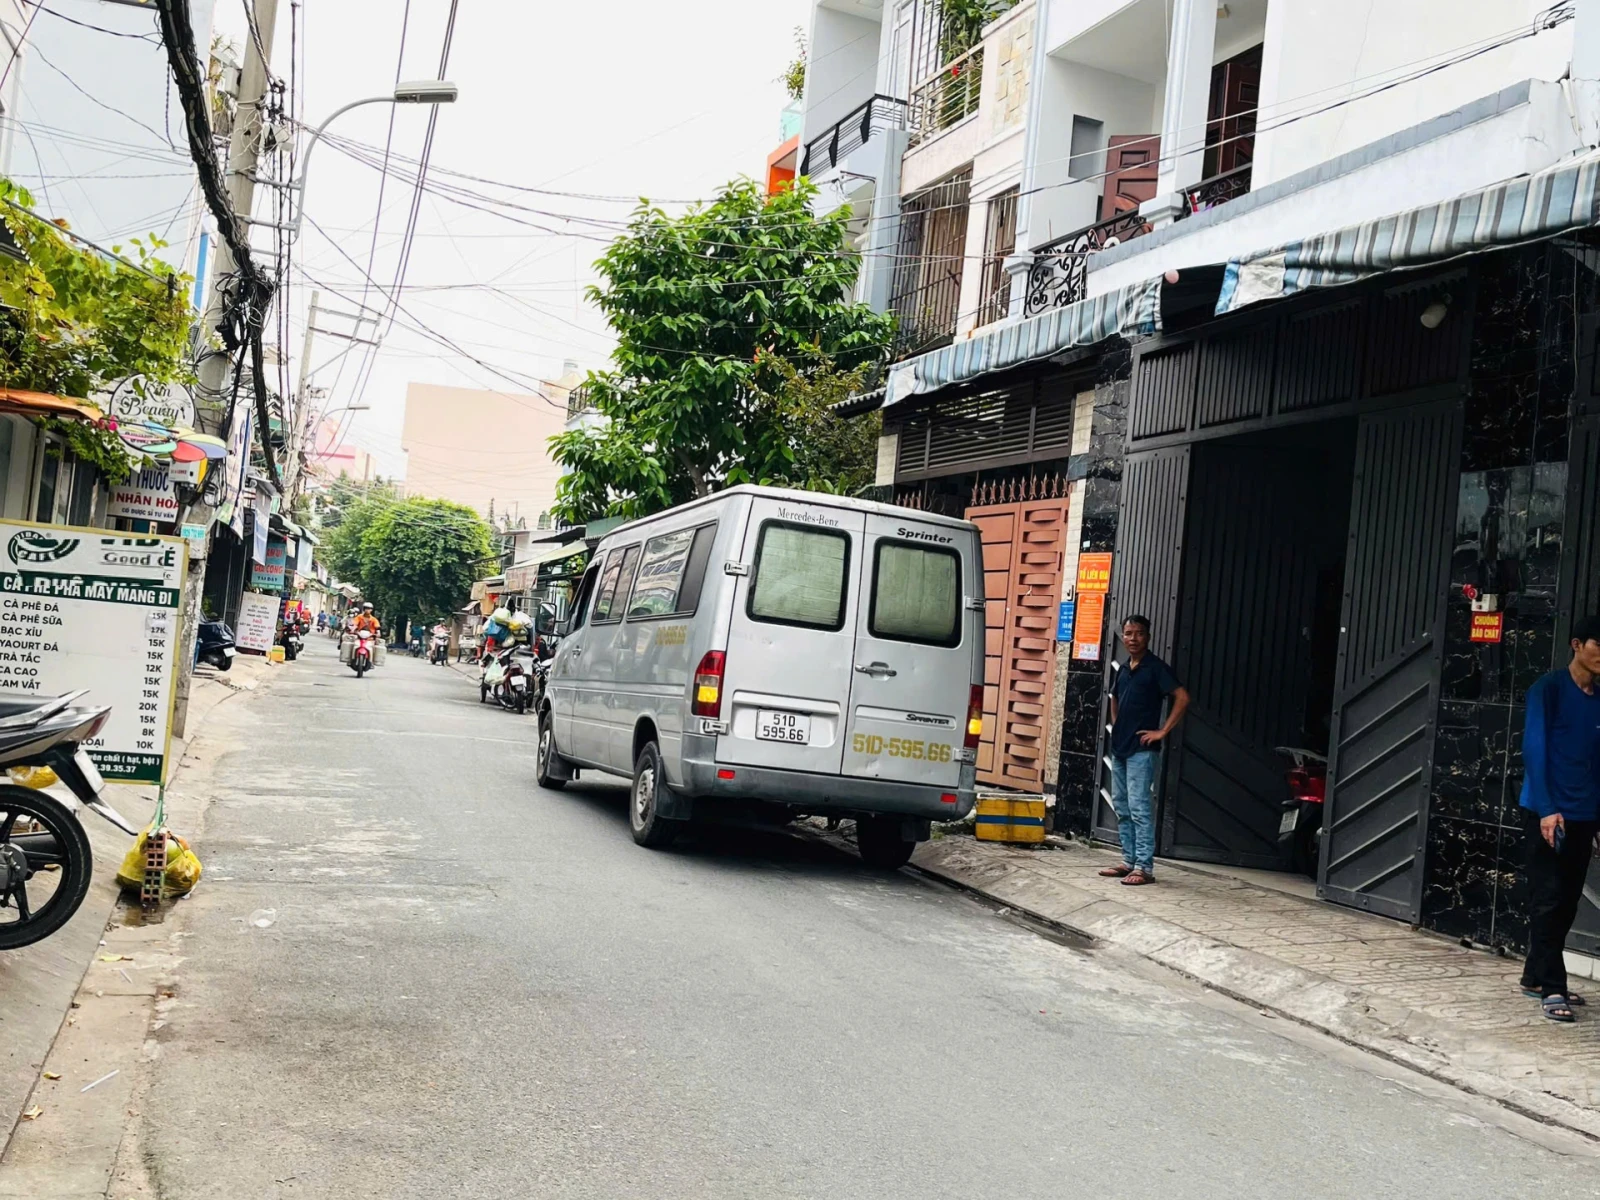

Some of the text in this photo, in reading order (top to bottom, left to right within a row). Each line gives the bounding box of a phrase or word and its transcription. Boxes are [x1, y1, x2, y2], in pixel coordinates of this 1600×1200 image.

[119, 397, 180, 422] Beauty
[116, 491, 180, 509] NHÂN HÒA
[777, 507, 839, 527] Mercedes-Benz
[897, 527, 953, 544] Sprinter
[103, 551, 151, 566] Good
[117, 588, 156, 604] MANG
[158, 591, 172, 605] ĐI
[21, 601, 42, 611] PHÊ
[44, 602, 60, 613] ĐÁ
[20, 614, 40, 624] PHÊ
[42, 615, 63, 626] SỮA
[0, 626, 23, 637] BẠC
[0, 639, 59, 652] YAOURT ĐÁ
[148, 639, 166, 647] 15K
[147, 651, 164, 660] 15K
[14, 667, 38, 677] CAO
[145, 664, 162, 673] 12K
[144, 677, 161, 686] 15K
[142, 690, 159, 698] 15K
[138, 702, 158, 711] 20K
[140, 715, 156, 724] 15K
[773, 713, 796, 727] 51D
[906, 713, 950, 725] SPRINTER
[142, 728, 155, 737] 8K
[763, 725, 804, 741] 595.66
[136, 740, 154, 749] 10K
[852, 732, 952, 763] 51D-595.66
